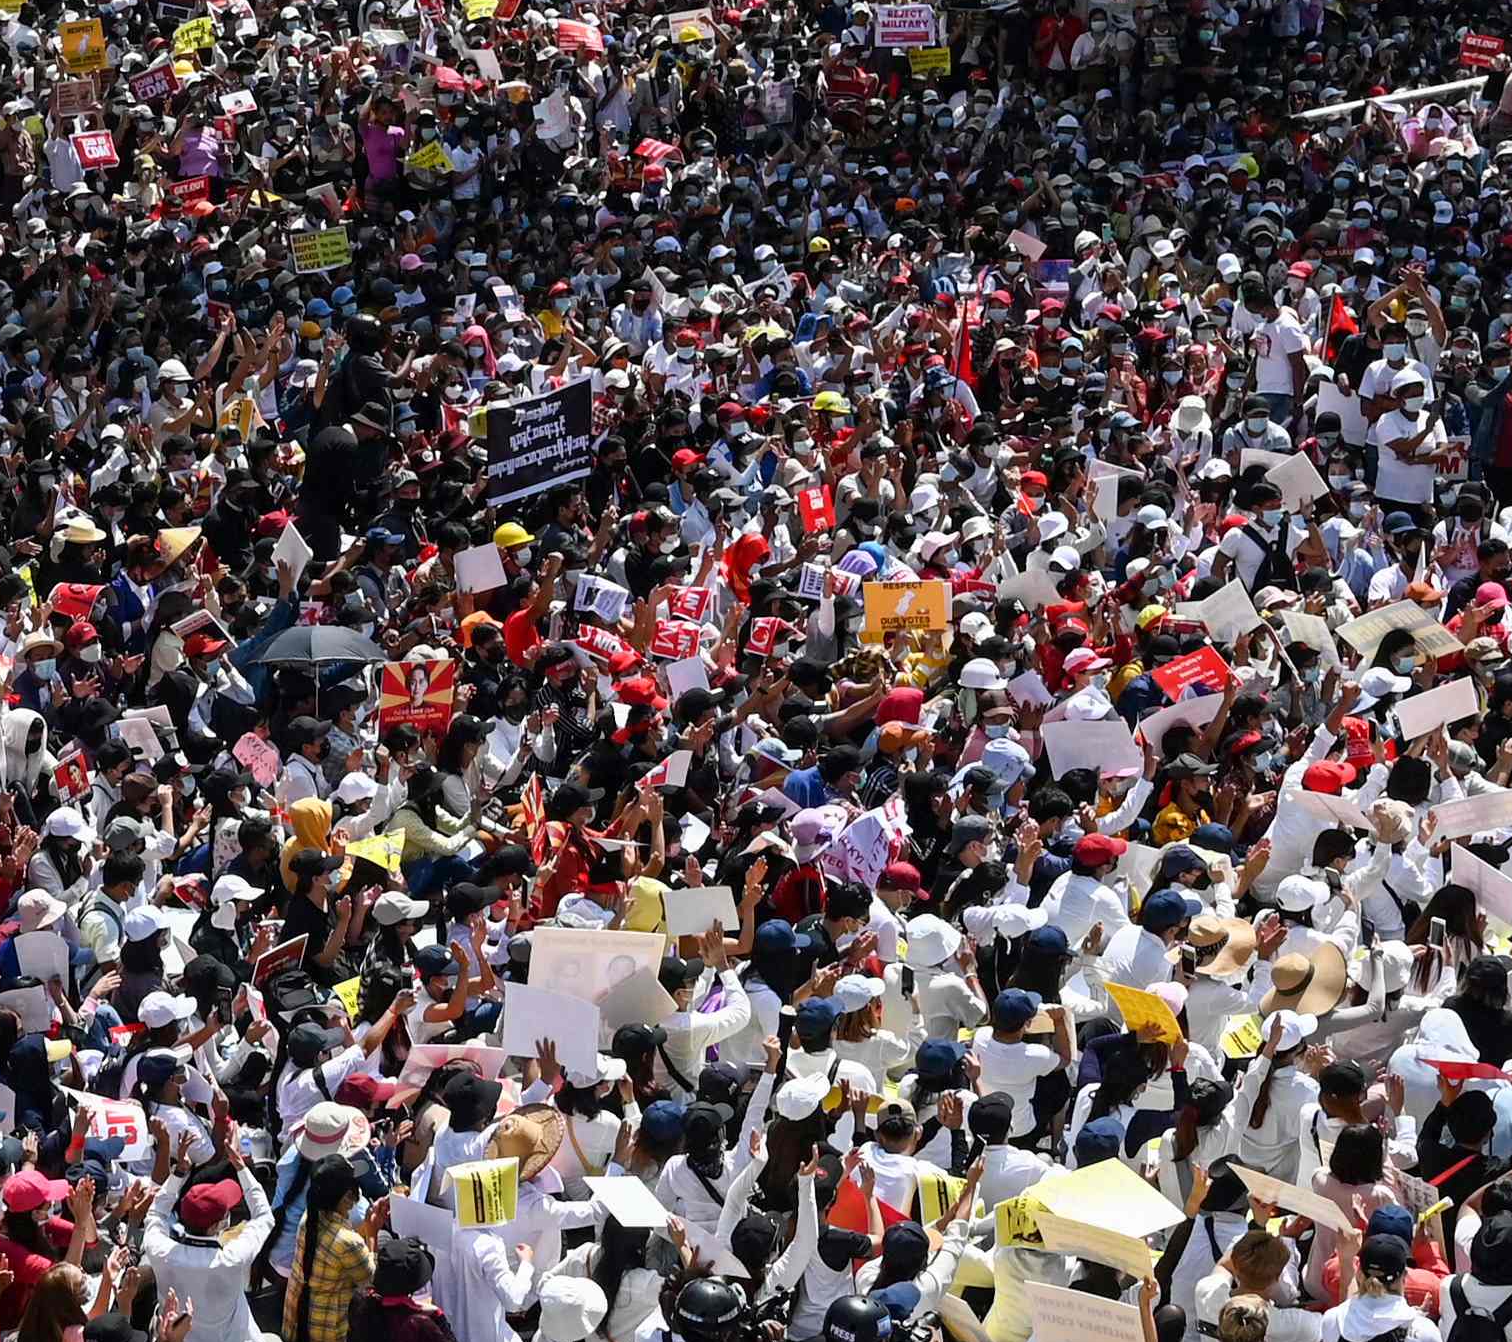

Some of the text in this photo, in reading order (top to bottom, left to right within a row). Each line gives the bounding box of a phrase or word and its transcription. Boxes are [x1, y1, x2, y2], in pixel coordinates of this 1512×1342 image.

[886, 9, 923, 19] REJECT
[881, 19, 929, 29] MILITARY
[1466, 36, 1499, 49] GET OUT
[174, 179, 205, 195] GET OUT
[882, 581, 925, 591] RESPECT
[880, 616, 932, 626] OUR VOTES
[829, 1323, 856, 1342] PRESS
